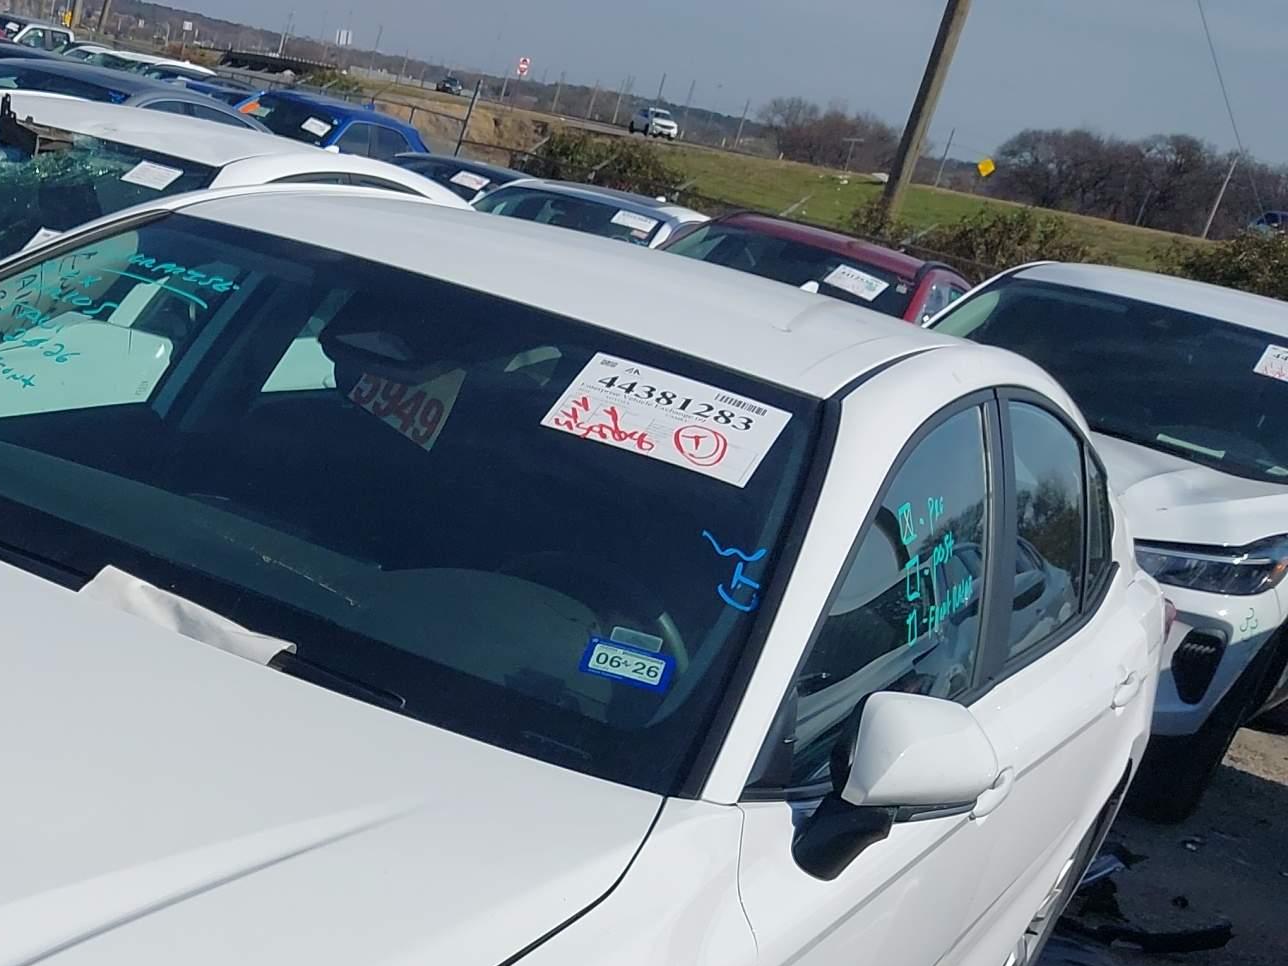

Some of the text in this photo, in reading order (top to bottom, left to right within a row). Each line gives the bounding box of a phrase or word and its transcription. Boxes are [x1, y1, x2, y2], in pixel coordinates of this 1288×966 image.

[598, 375, 754, 432] 44381283
[595, 652, 660, 679] 06 26
